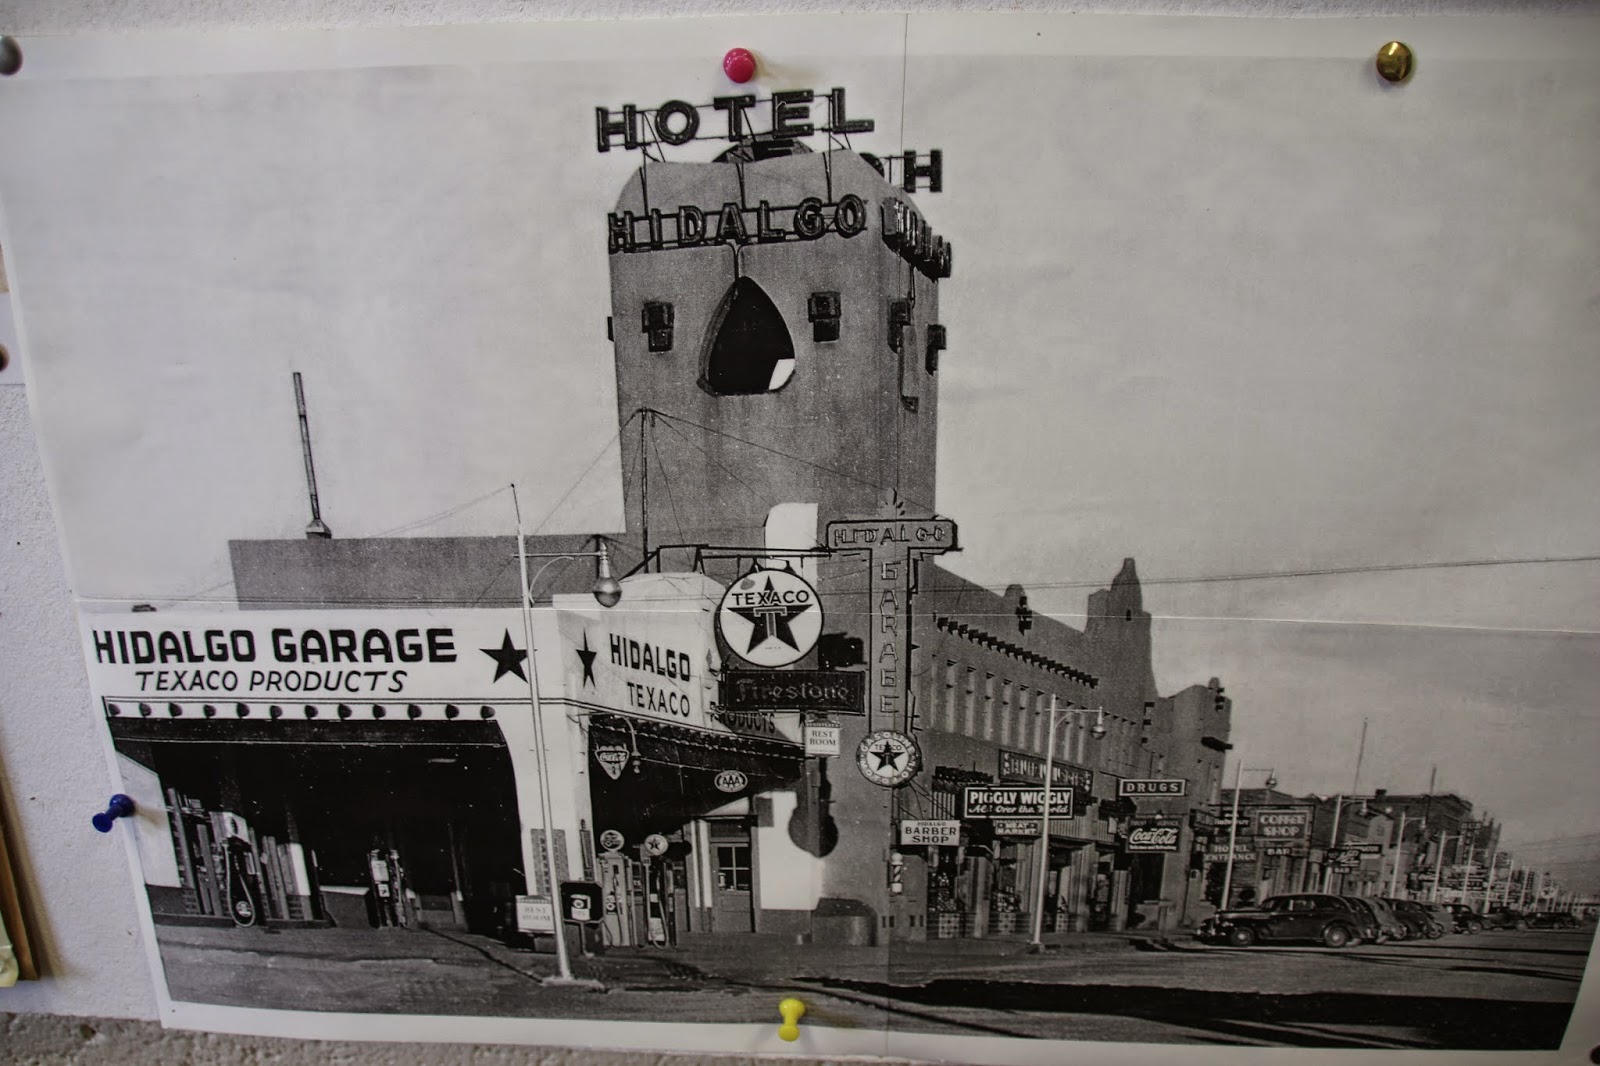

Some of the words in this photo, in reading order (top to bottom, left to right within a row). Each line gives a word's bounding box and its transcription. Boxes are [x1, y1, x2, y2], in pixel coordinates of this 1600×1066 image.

[595, 87, 875, 152] HOTEL
[607, 194, 867, 254] HIDALGO
[834, 525, 946, 547] HIDALGO
[731, 589, 811, 605] TEXACO
[879, 561, 902, 713] GARAGE
[93, 629, 256, 664] HIDALGO
[273, 628, 458, 664] GARAGE
[608, 632, 691, 682] HIDALGO
[135, 670, 239, 692] TEXACO
[249, 670, 408, 694] PRODUCTS
[736, 678, 850, 702] Firestone
[627, 681, 691, 718] TEXACO
[812, 730, 833, 738] REST
[809, 738, 836, 746] ROOM
[722, 775, 740, 788] AAA
[1126, 783, 1179, 792] DRUGS
[969, 791, 1018, 804] PIGGLY
[1020, 791, 1070, 804] WIGGLY
[1037, 805, 1069, 813] Wrld
[1260, 815, 1305, 825] COFFEE
[905, 827, 957, 836] BARBER
[1129, 828, 1179, 844] Coca-Cola
[1263, 826, 1300, 836] SHOP
[912, 836, 949, 844] SHOP
[1214, 844, 1250, 852] HOEL
[1267, 848, 1291, 856] BAR
[522, 914, 551, 922] ROOM
